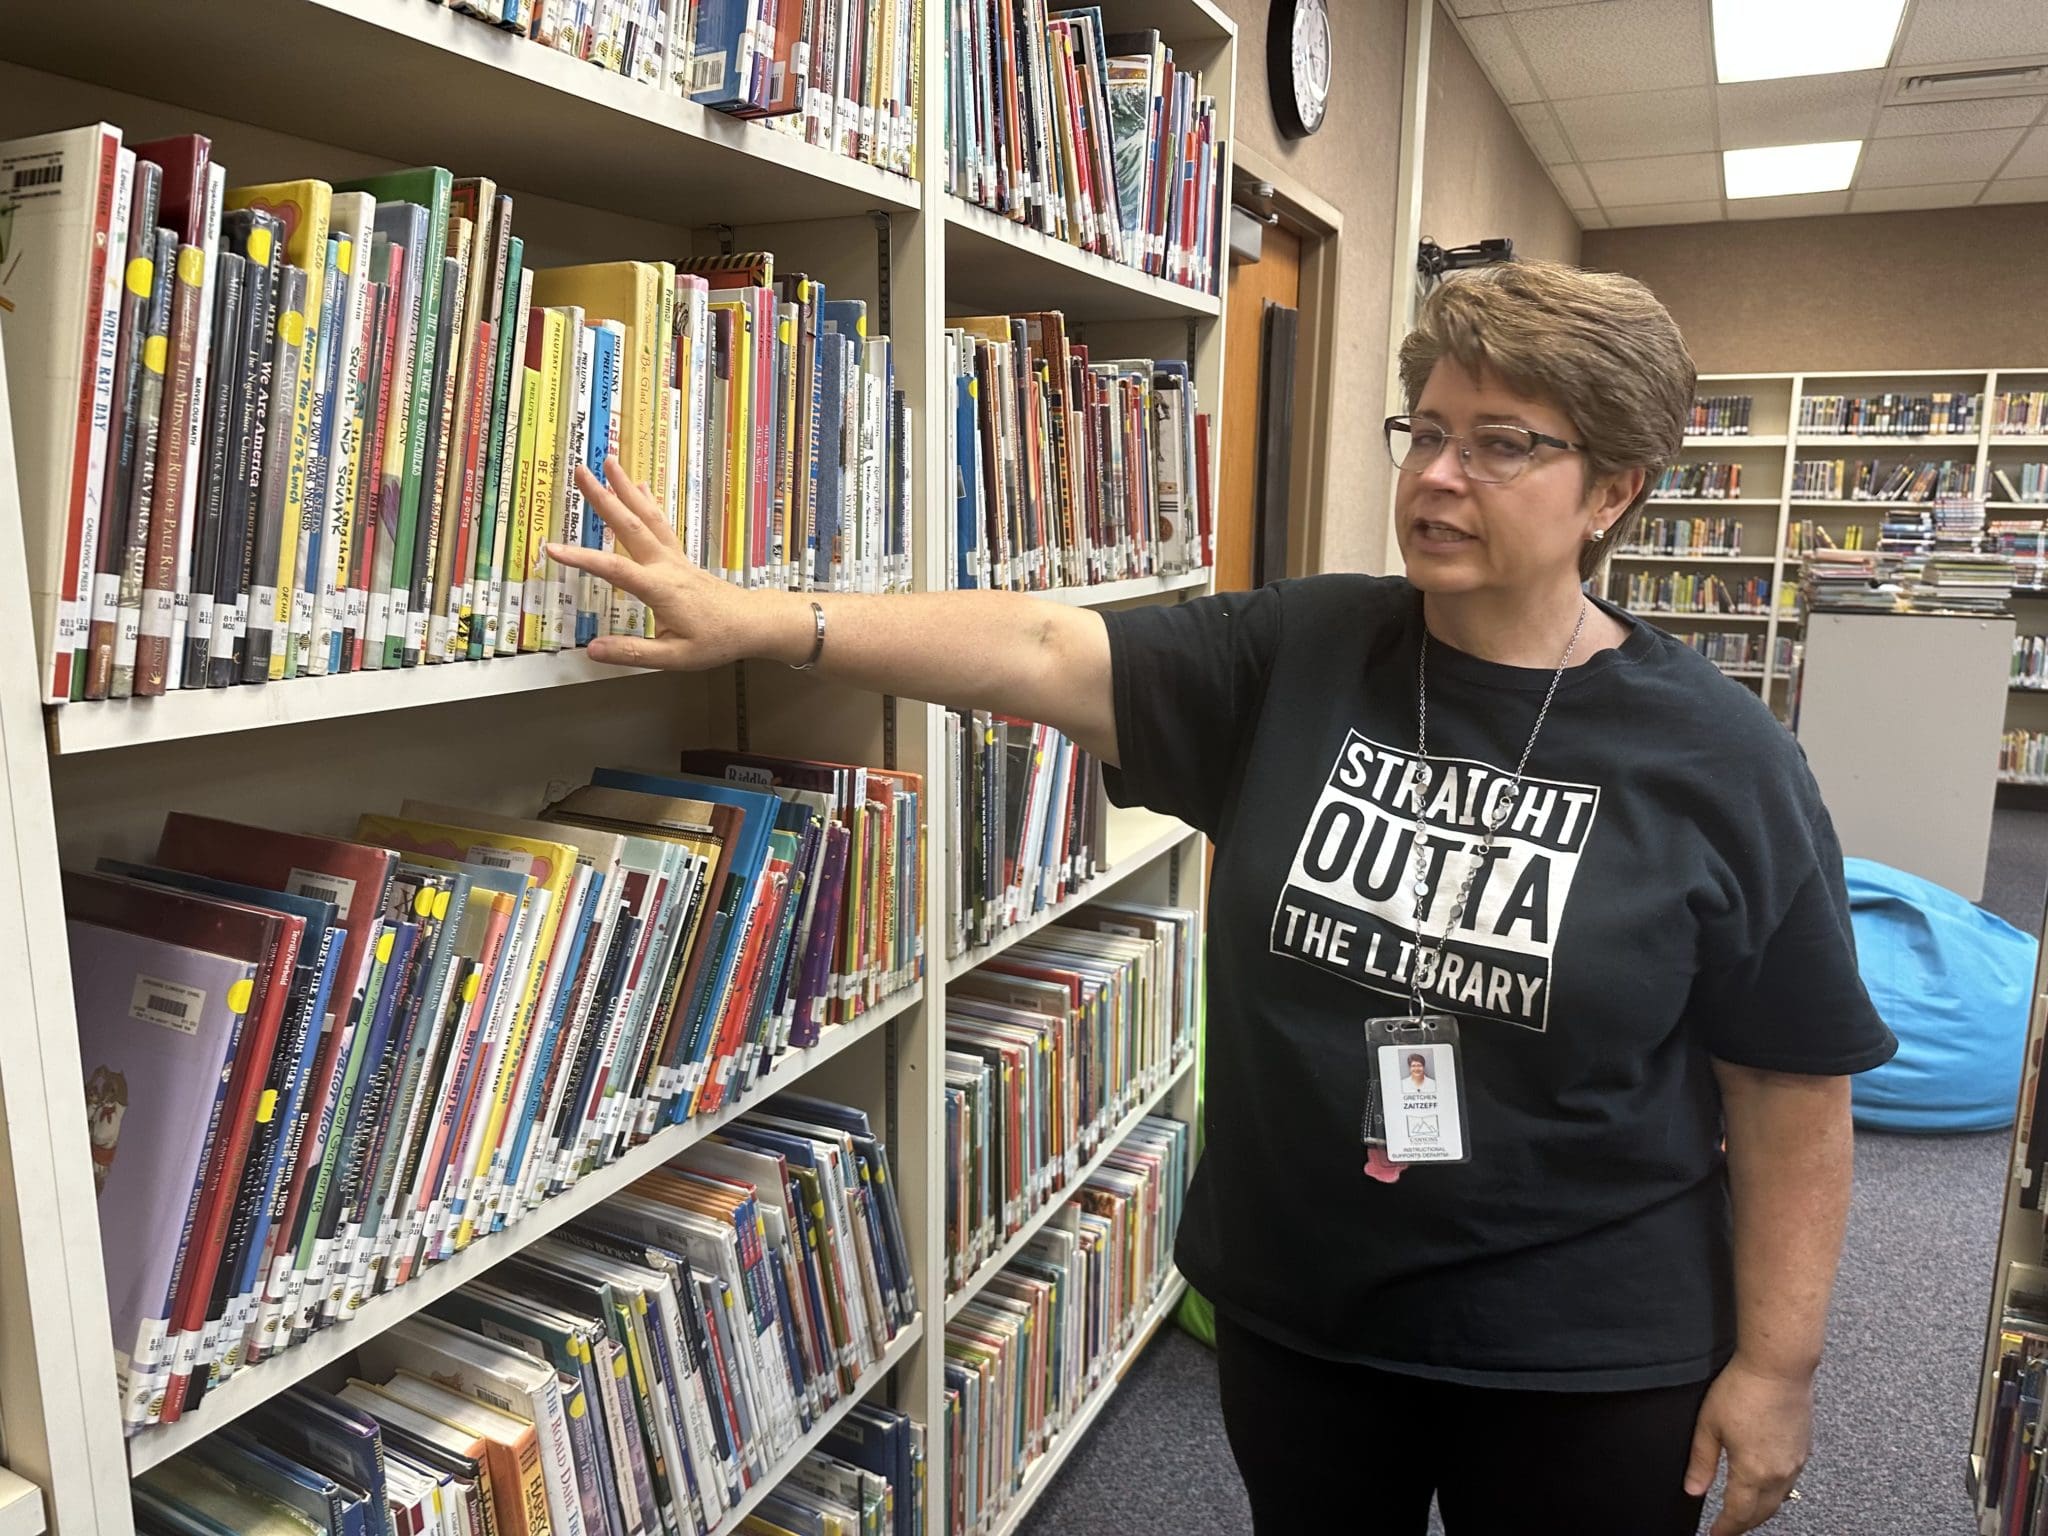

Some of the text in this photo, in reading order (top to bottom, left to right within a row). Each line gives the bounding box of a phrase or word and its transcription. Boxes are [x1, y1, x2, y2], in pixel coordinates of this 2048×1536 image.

[160, 248, 177, 335] LONGFELLOW
[227, 278, 241, 311] Miller
[265, 240, 283, 344] MYERS MYERS
[354, 226, 374, 321] Pearson Slonim
[363, 296, 374, 328] PERRY
[411, 295, 422, 326] RIDE
[101, 310, 118, 358] WORLD
[302, 327, 317, 375] Never
[385, 337, 395, 361] THE
[98, 365, 112, 397] RAT
[278, 353, 297, 414] CARVER
[403, 339, 417, 389] PURPLE
[476, 340, 490, 390] prelutsky
[548, 321, 561, 424] PRELUTSKY STEVENSON
[579, 351, 589, 396] PRELUTSKY
[600, 350, 612, 413] PRELUTSKY
[640, 355, 651, 373] Be
[189, 377, 203, 446] MARVELOUS MATH
[215, 384, 230, 418] POEMS
[297, 377, 311, 411] Take
[312, 392, 324, 422] DOGS
[411, 312, 438, 477] THE FROGS WORE RED SUSPENDERS
[526, 381, 536, 428] PRELUTSKY
[639, 376, 650, 405] Glad
[660, 390, 670, 422] CHARGE
[94, 402, 110, 432] DAY
[143, 414, 160, 457] PAUL
[168, 389, 190, 456] MIDNIGHT
[239, 350, 260, 481] The Night Before Christmas
[248, 361, 274, 488] We Are America
[398, 390, 411, 446] PELICAN
[638, 407, 648, 428] Your
[331, 346, 360, 536] SQUEAL AND SQUAWK
[349, 428, 361, 454] the
[477, 449, 487, 471] THE
[492, 430, 505, 489] UMBRELLA
[638, 428, 648, 459] Nose
[658, 439, 667, 464] RULES
[166, 460, 183, 496] RIDE
[289, 465, 303, 505] Lunch
[306, 456, 316, 484] WEAR
[537, 458, 548, 475] BE
[568, 410, 586, 542] The New the Block
[656, 466, 666, 495] WOULD
[786, 450, 794, 479] BUTTON
[164, 497, 177, 513] OF
[208, 488, 222, 520] WHITE
[301, 486, 315, 531] SNEAKERS
[310, 456, 328, 535] SILVER SEEDS
[460, 468, 475, 529] good sports
[473, 475, 484, 506] ROOF
[533, 491, 546, 532] GENIUS
[808, 478, 818, 537] PATTERNS
[80, 517, 95, 592] CANDLEWICK PRESS
[161, 518, 178, 556] PAUL
[336, 510, 351, 573] smasher
[159, 557, 175, 592] REVE
[728, 768, 768, 786] Riddle
[1338, 741, 1594, 846] STRAIGHT
[380, 874, 395, 912] WHEELER
[1302, 800, 1552, 944] OUTTA
[739, 922, 755, 954] LAUGH
[1282, 904, 1545, 1018] THE LIBRARY
[294, 995, 316, 1054] FREEDOM
[499, 959, 548, 1105] Never Lunch
[506, 1011, 519, 1033] KICK
[582, 995, 602, 1041] YELLOW
[596, 996, 618, 1050] CITY NIGHT
[604, 990, 633, 1066] TOUR AMERICA
[499, 1048, 509, 1066] THE
[562, 1045, 588, 1107] ELEPHANT
[386, 1088, 399, 1112] Diner
[420, 1085, 435, 1119] SHAPE
[448, 1058, 470, 1103] Laundry
[491, 1067, 504, 1094] HEAD
[442, 1104, 456, 1126] Pile
[526, 1099, 538, 1122] NOD
[1403, 1102, 1439, 1110] ZAITZEFF
[274, 1111, 310, 1218] Birmingham, 1963
[311, 1086, 354, 1214] Wool Gathering
[379, 1151, 397, 1192] FOREST
[265, 1166, 286, 1218] DUMPER
[545, 1380, 558, 1418] THE
[551, 1416, 568, 1472] ROALD
[530, 1473, 550, 1534] HARRY
[560, 1468, 576, 1512] DAHL
